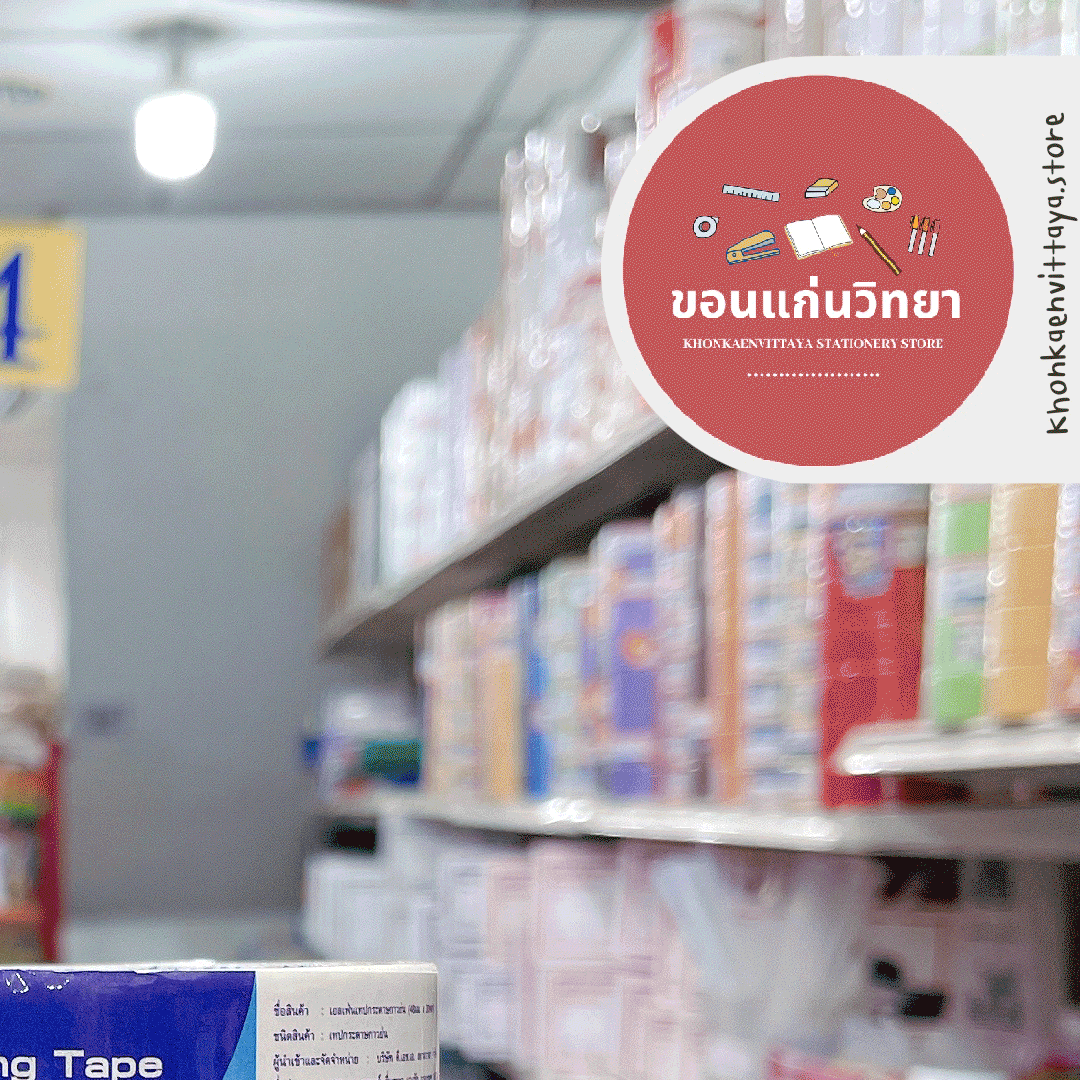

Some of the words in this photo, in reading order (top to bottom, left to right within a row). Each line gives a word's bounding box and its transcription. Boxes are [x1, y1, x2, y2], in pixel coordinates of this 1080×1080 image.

[273, 1000, 309, 1017] ชื่อสินค้า
[273, 1028, 315, 1042] ชนิดสินค้า
